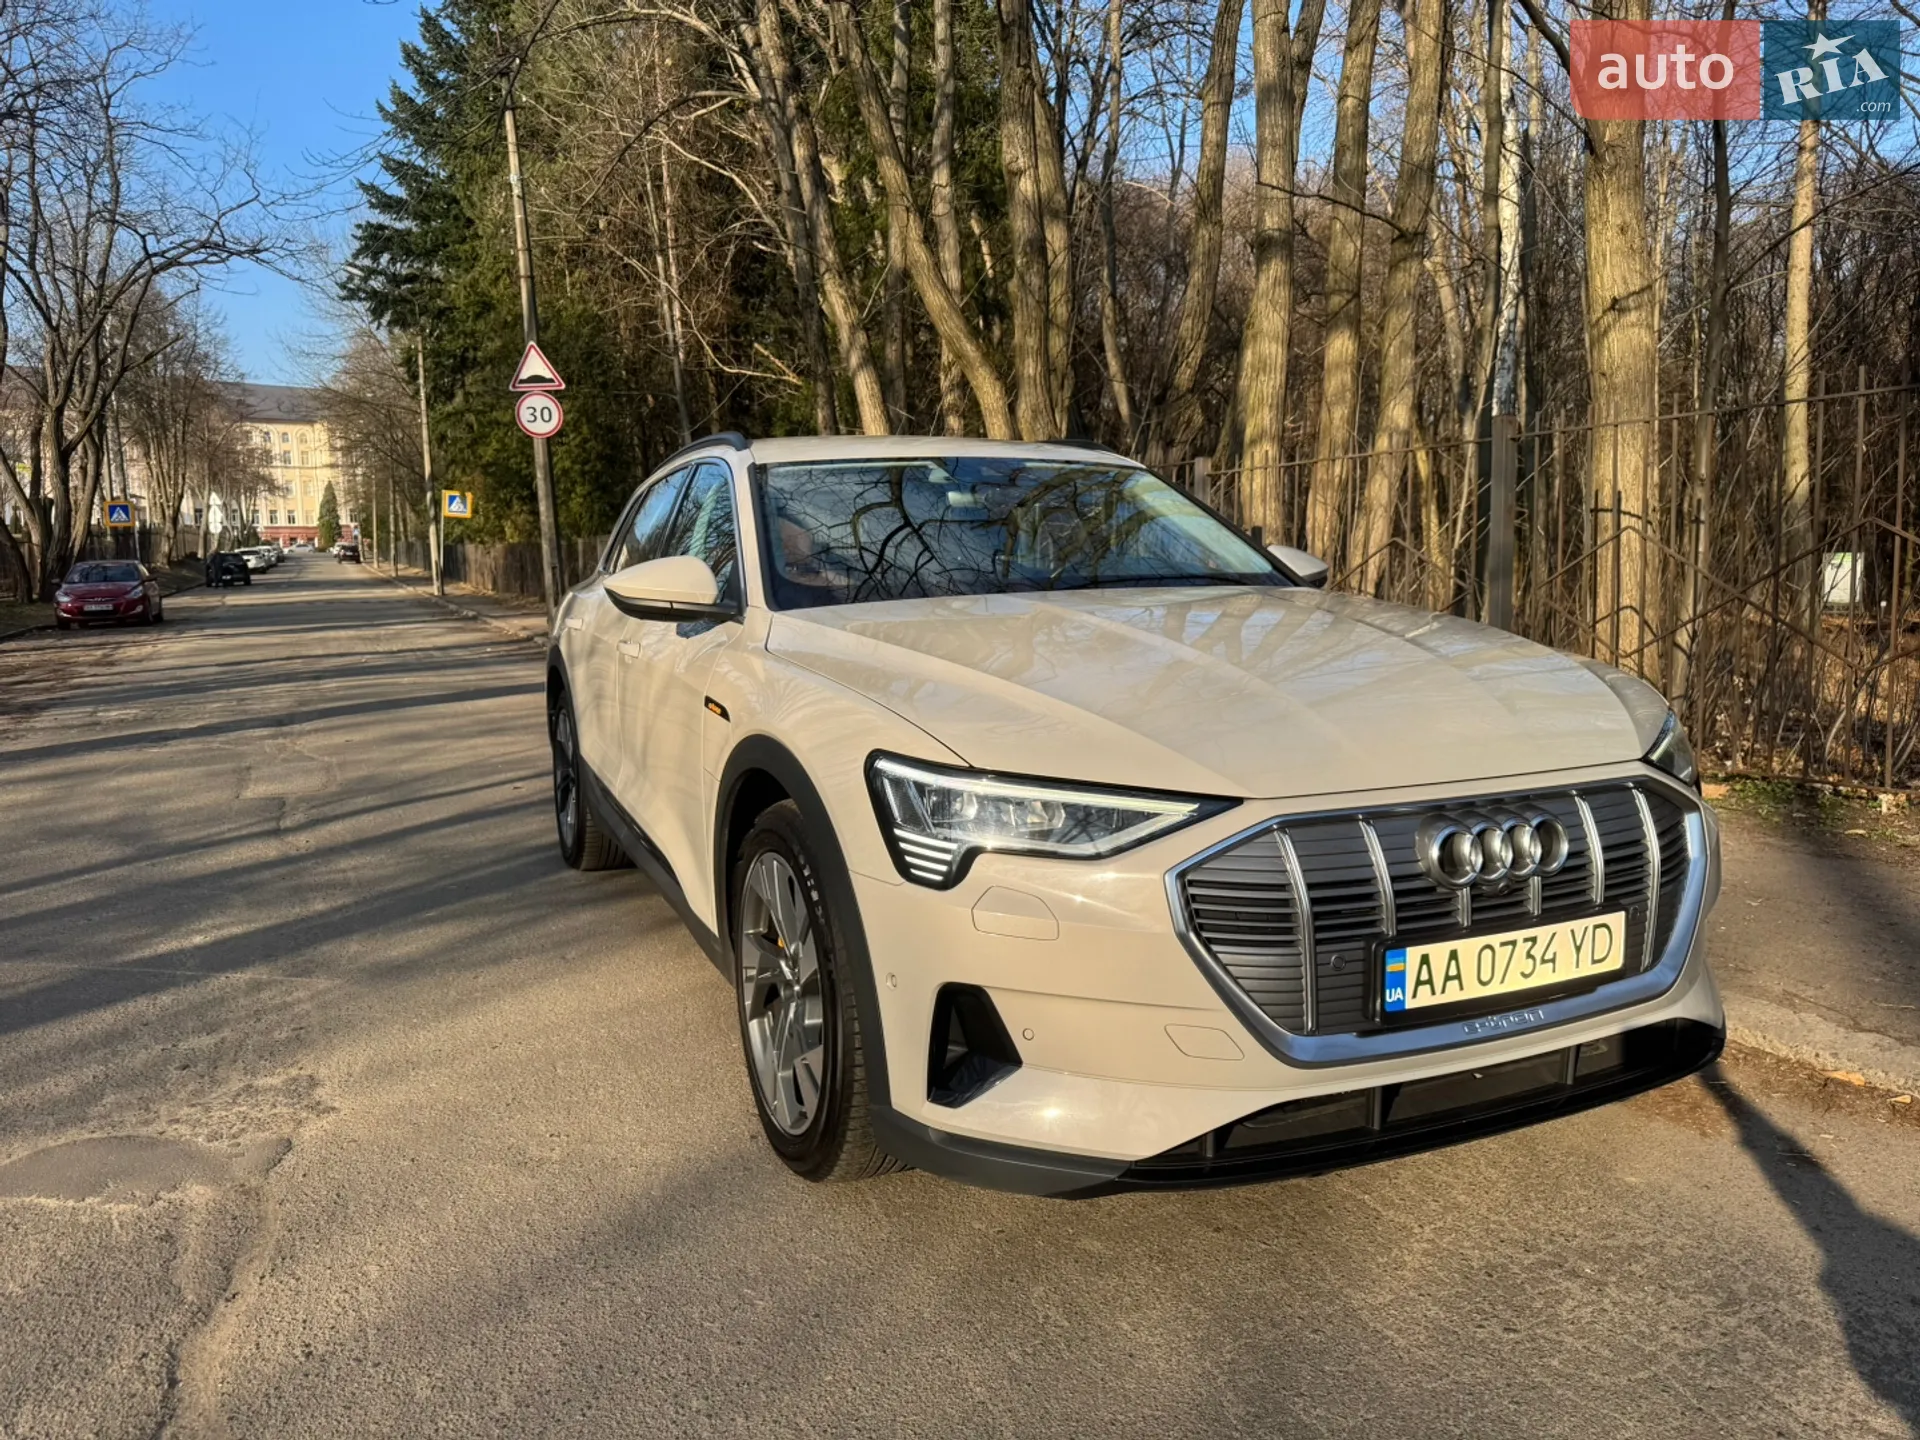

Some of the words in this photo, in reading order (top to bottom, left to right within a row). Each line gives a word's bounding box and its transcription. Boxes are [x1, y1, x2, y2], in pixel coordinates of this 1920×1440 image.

[526, 406, 553, 424] 30
[1411, 948, 1464, 1000] AA
[1476, 931, 1557, 987] 0734
[1569, 922, 1614, 969] YD
[1385, 986, 1404, 1003] UA
